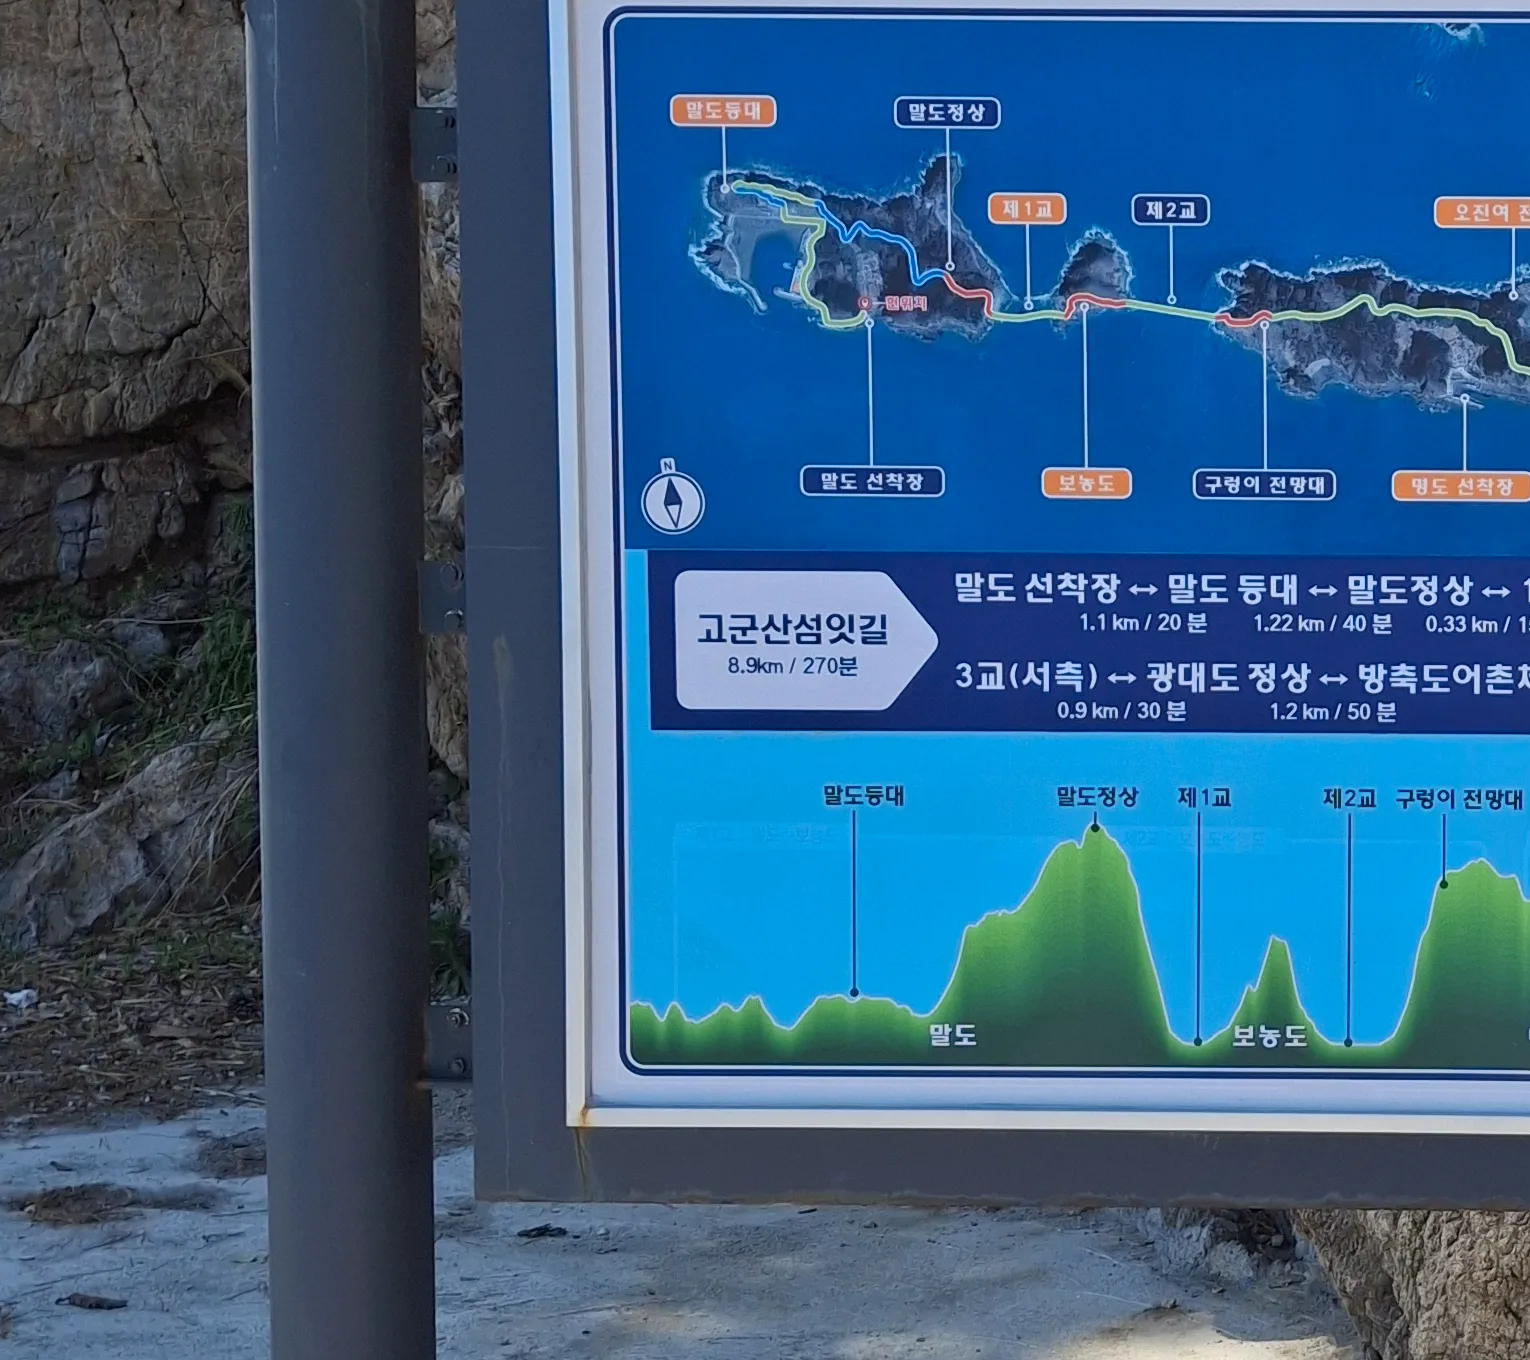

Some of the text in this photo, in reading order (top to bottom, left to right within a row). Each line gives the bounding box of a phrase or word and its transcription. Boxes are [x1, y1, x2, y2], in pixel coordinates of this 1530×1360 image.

[684, 100, 763, 122] 말도등대
[909, 104, 985, 122] 말도정상
[1003, 200, 1052, 218] 제1교
[1147, 201, 1196, 219] 제2교
[1454, 204, 1514, 222] 오진여
[664, 459, 674, 470] N
[822, 473, 924, 491] 말도 선착장
[1057, 474, 1116, 493] 보농도
[1205, 476, 1324, 494] 구렁이 전망대
[1410, 475, 1516, 498] 명도 선착장
[956, 572, 1016, 602] 말도
[1025, 573, 1120, 604] 선착장
[1169, 574, 1228, 603] 말도
[1238, 575, 1297, 605] 등대
[1349, 575, 1473, 606] 말도정상
[698, 614, 887, 645] 고군산섬잇길
[1081, 613, 1207, 633] 1.1 km / 20 분
[1255, 614, 1392, 634] 1.22 km / 40 분
[1426, 616, 1466, 632] 0.33
[1472, 616, 1498, 632] km
[1503, 616, 1510, 633] /
[728, 657, 858, 676] 8.9km / 270분
[956, 661, 1097, 692] 3교(서측)
[1147, 662, 1239, 693] 광대도
[1248, 663, 1311, 693] 정상
[1058, 701, 1186, 721] 0.9 km / 30 분
[1271, 702, 1396, 722] 1.2 km / 50 분
[824, 785, 903, 807] 말도등대
[1058, 786, 1139, 808] 말도정상
[1179, 788, 1231, 808] 제1교
[1324, 787, 1376, 809] 제2교
[1396, 788, 1522, 811] 구렁이 전망대
[930, 1024, 977, 1047] 말도
[1233, 1025, 1308, 1048] 보농도
